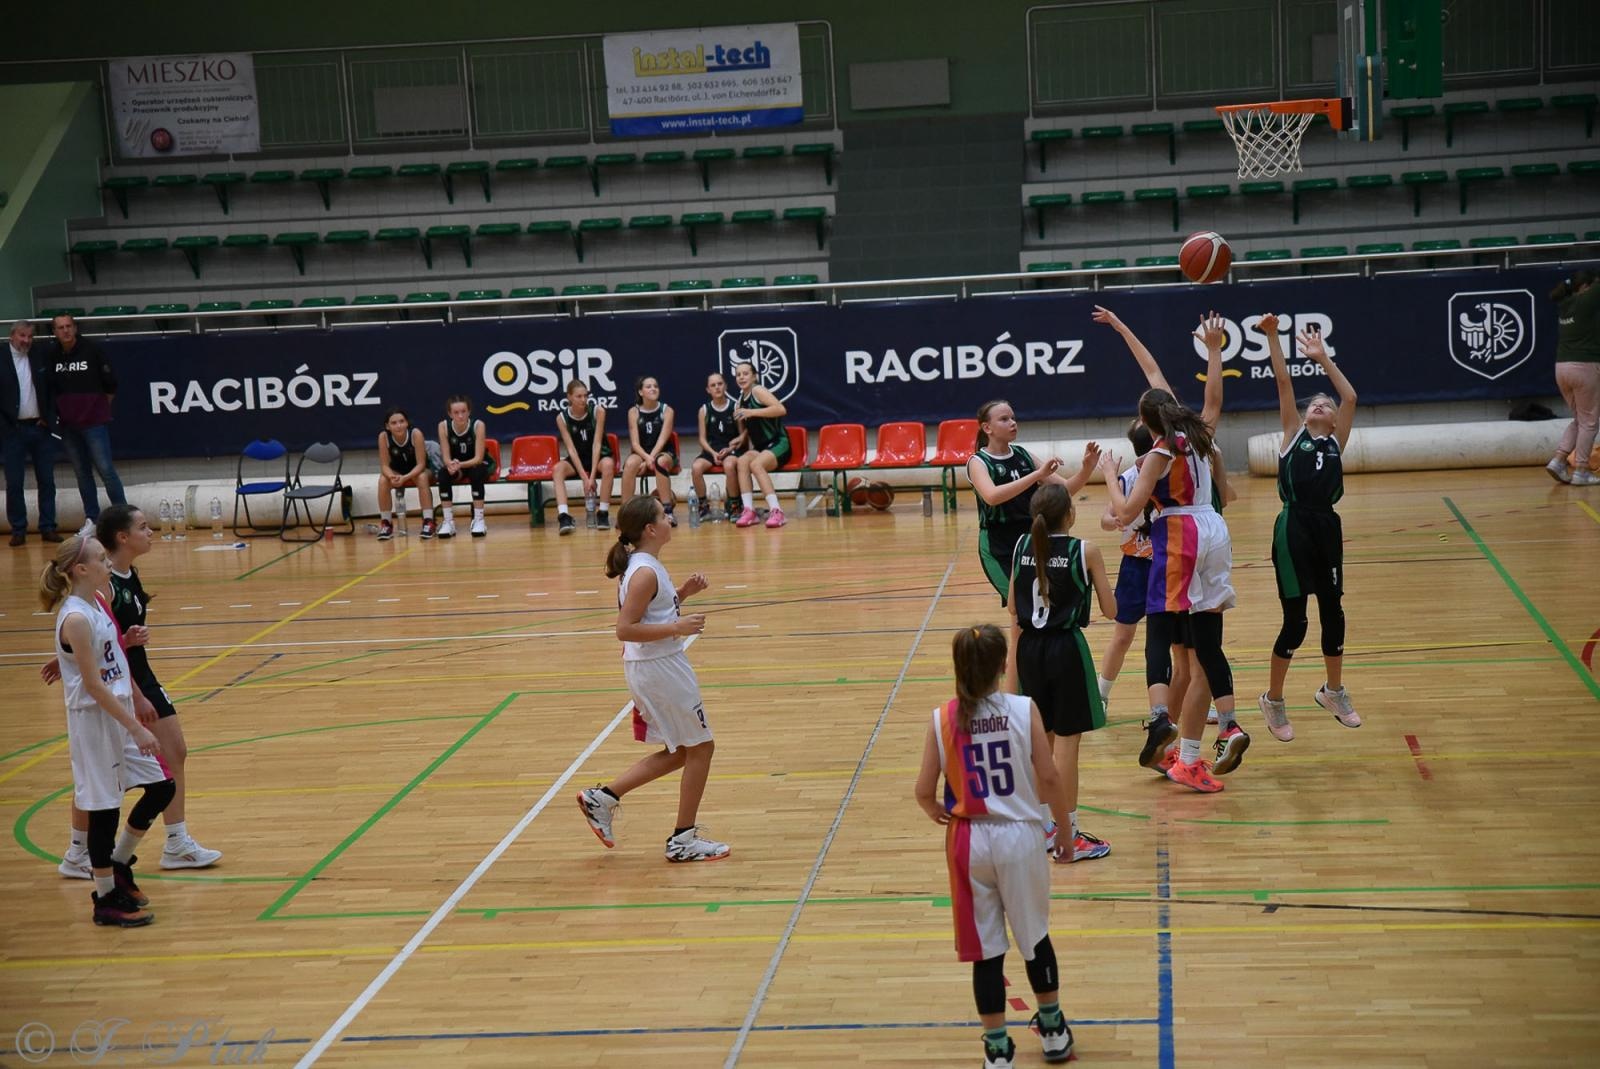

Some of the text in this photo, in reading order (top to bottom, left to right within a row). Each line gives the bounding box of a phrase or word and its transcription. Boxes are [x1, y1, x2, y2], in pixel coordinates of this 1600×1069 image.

[632, 41, 771, 74] instal-tech
[127, 59, 236, 84] MIESZKO
[131, 98, 164, 107] Operator
[712, 91, 727, 100] von
[132, 104, 219, 114] Pracownik produkcyjny
[177, 117, 210, 125] Czekamy
[661, 114, 752, 129] www.instal-tech.pl
[56, 361, 88, 372] PARIS
[845, 331, 1085, 384] RACIBÓRZ
[482, 348, 617, 397] OSiR
[149, 363, 381, 414] RACIBÓRZ
[538, 393, 618, 411] RACÓRZ
[645, 421, 653, 434] 13
[1315, 451, 1324, 470] 3
[104, 640, 115, 663] 2
[969, 714, 1009, 735] CIBÓRZ
[963, 740, 1015, 799] 55
